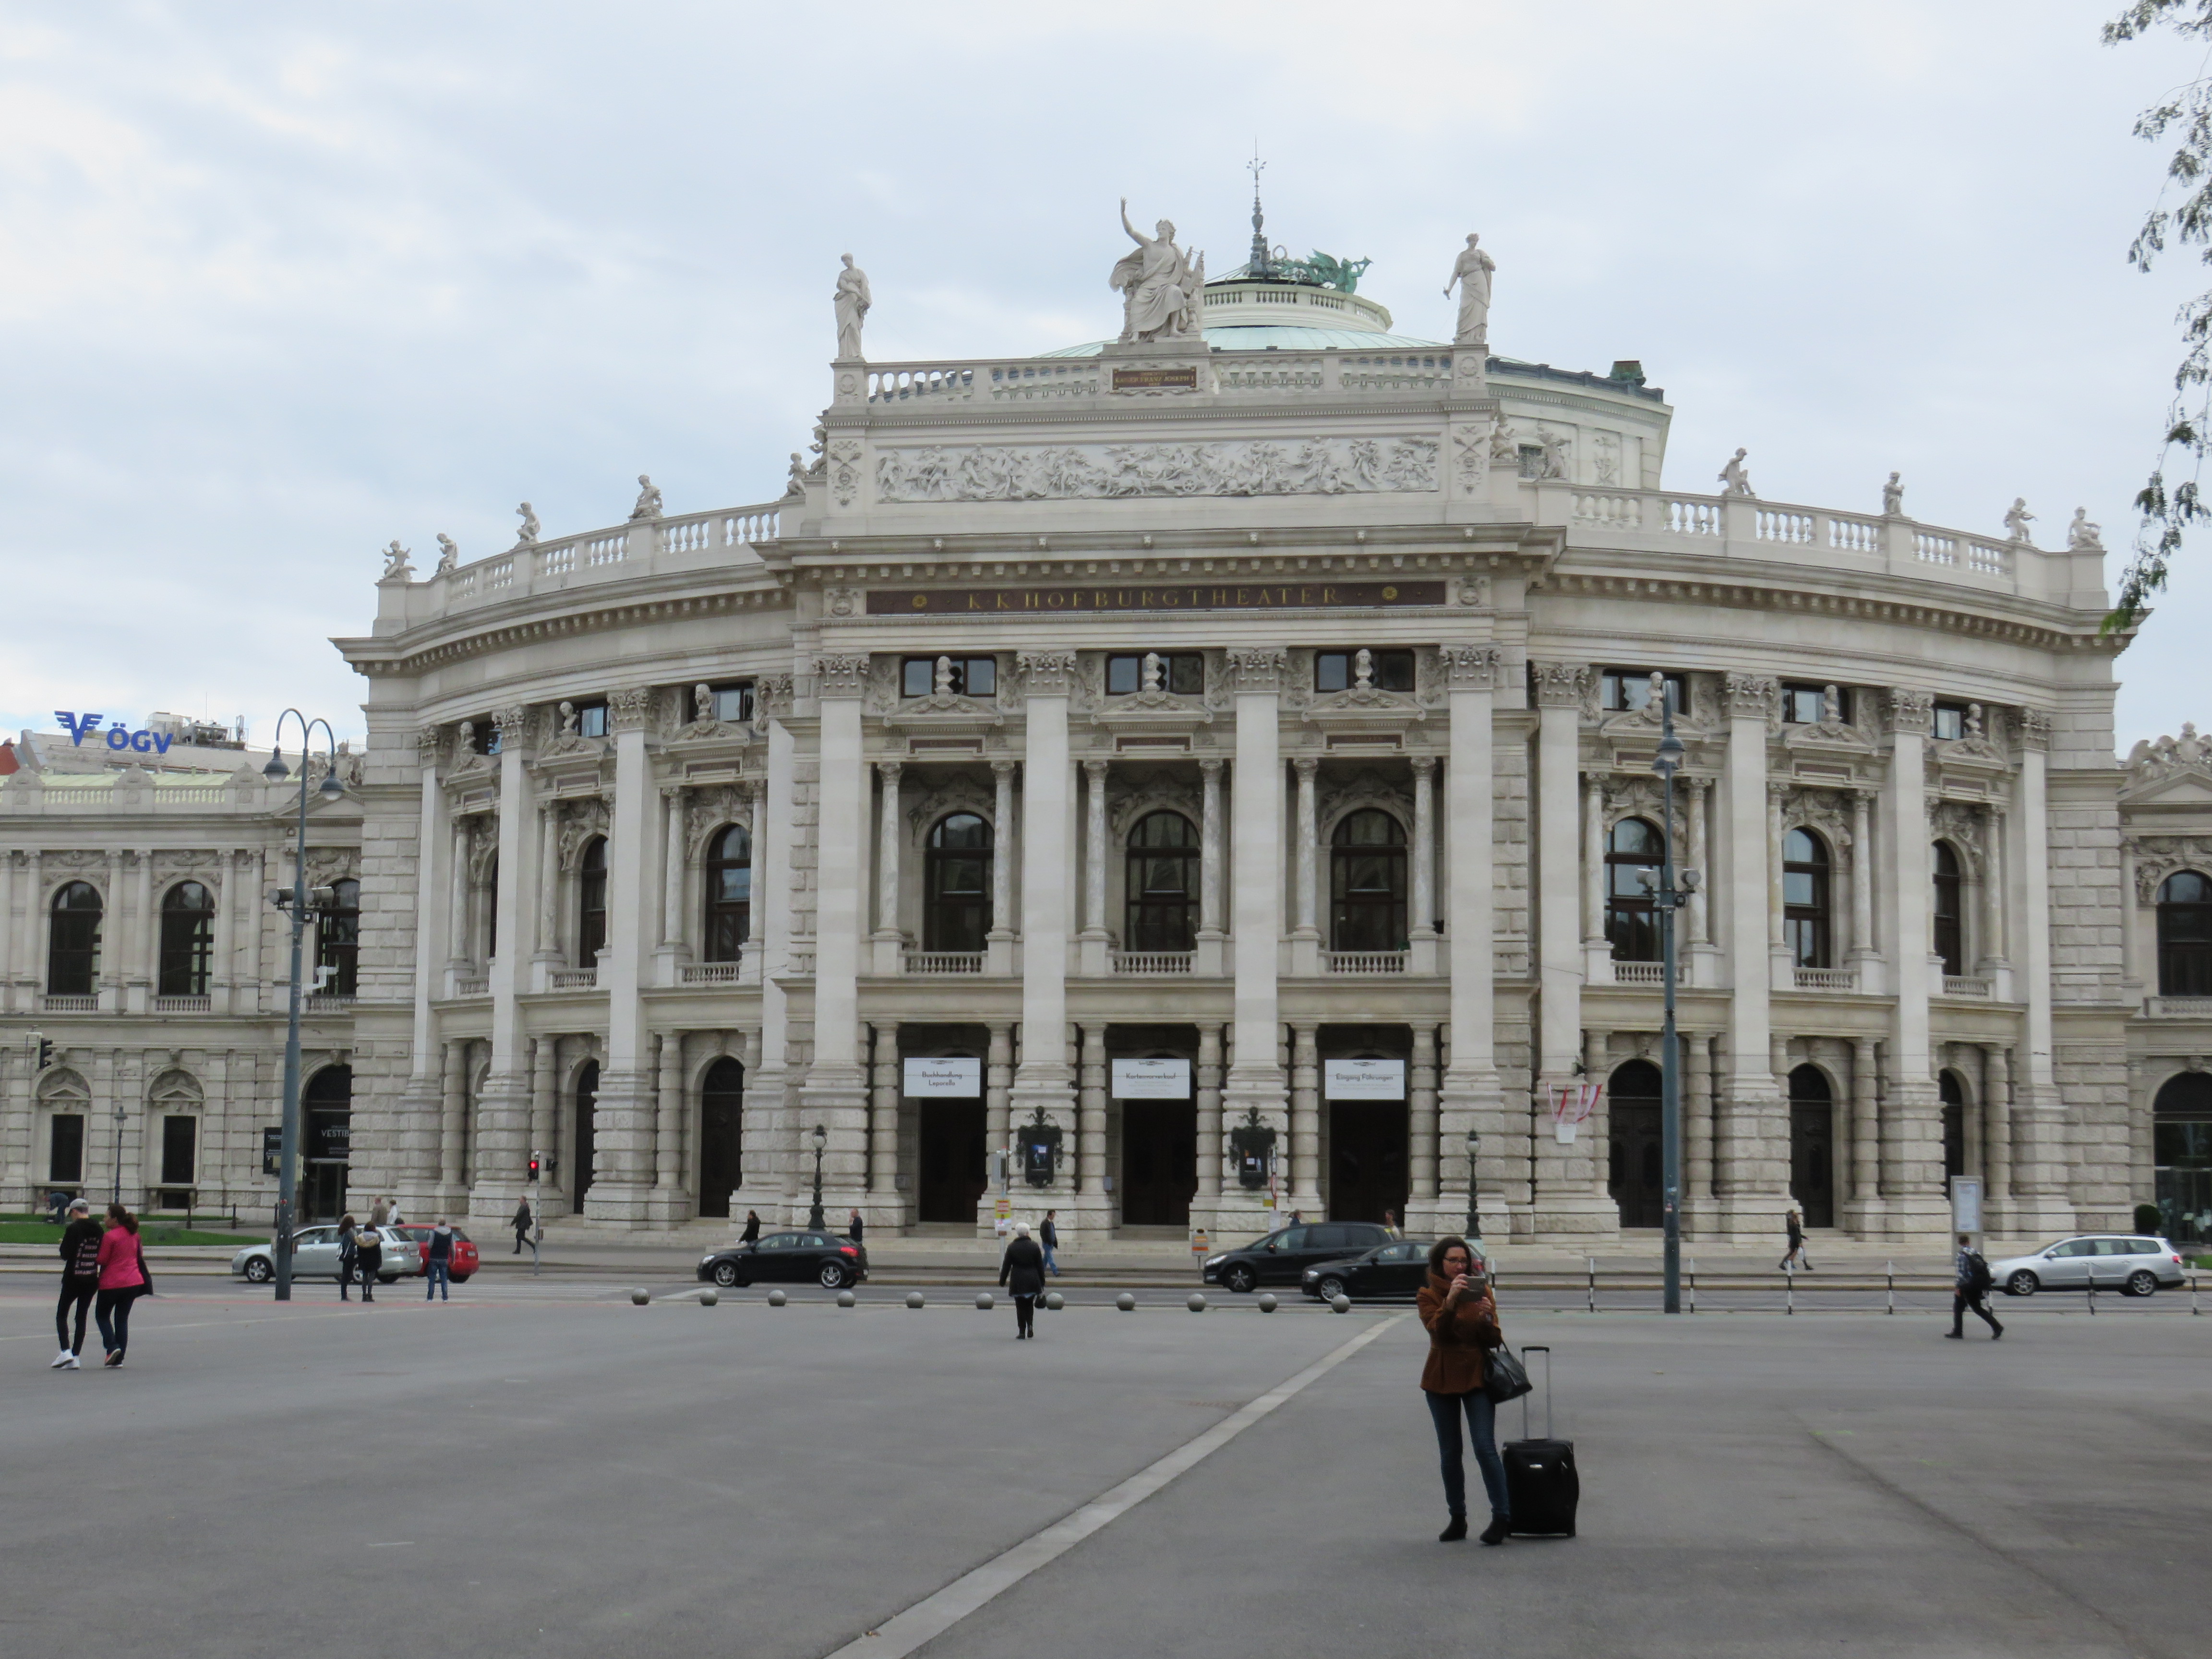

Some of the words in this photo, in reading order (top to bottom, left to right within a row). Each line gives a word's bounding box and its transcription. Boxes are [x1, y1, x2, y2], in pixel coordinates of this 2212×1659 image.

[107, 722, 173, 754] ÖGV
[922, 1071, 962, 1079] Buchhandlung
[1336, 1073, 1360, 1082] Eingang
[1362, 1072, 1394, 1082] Führungen
